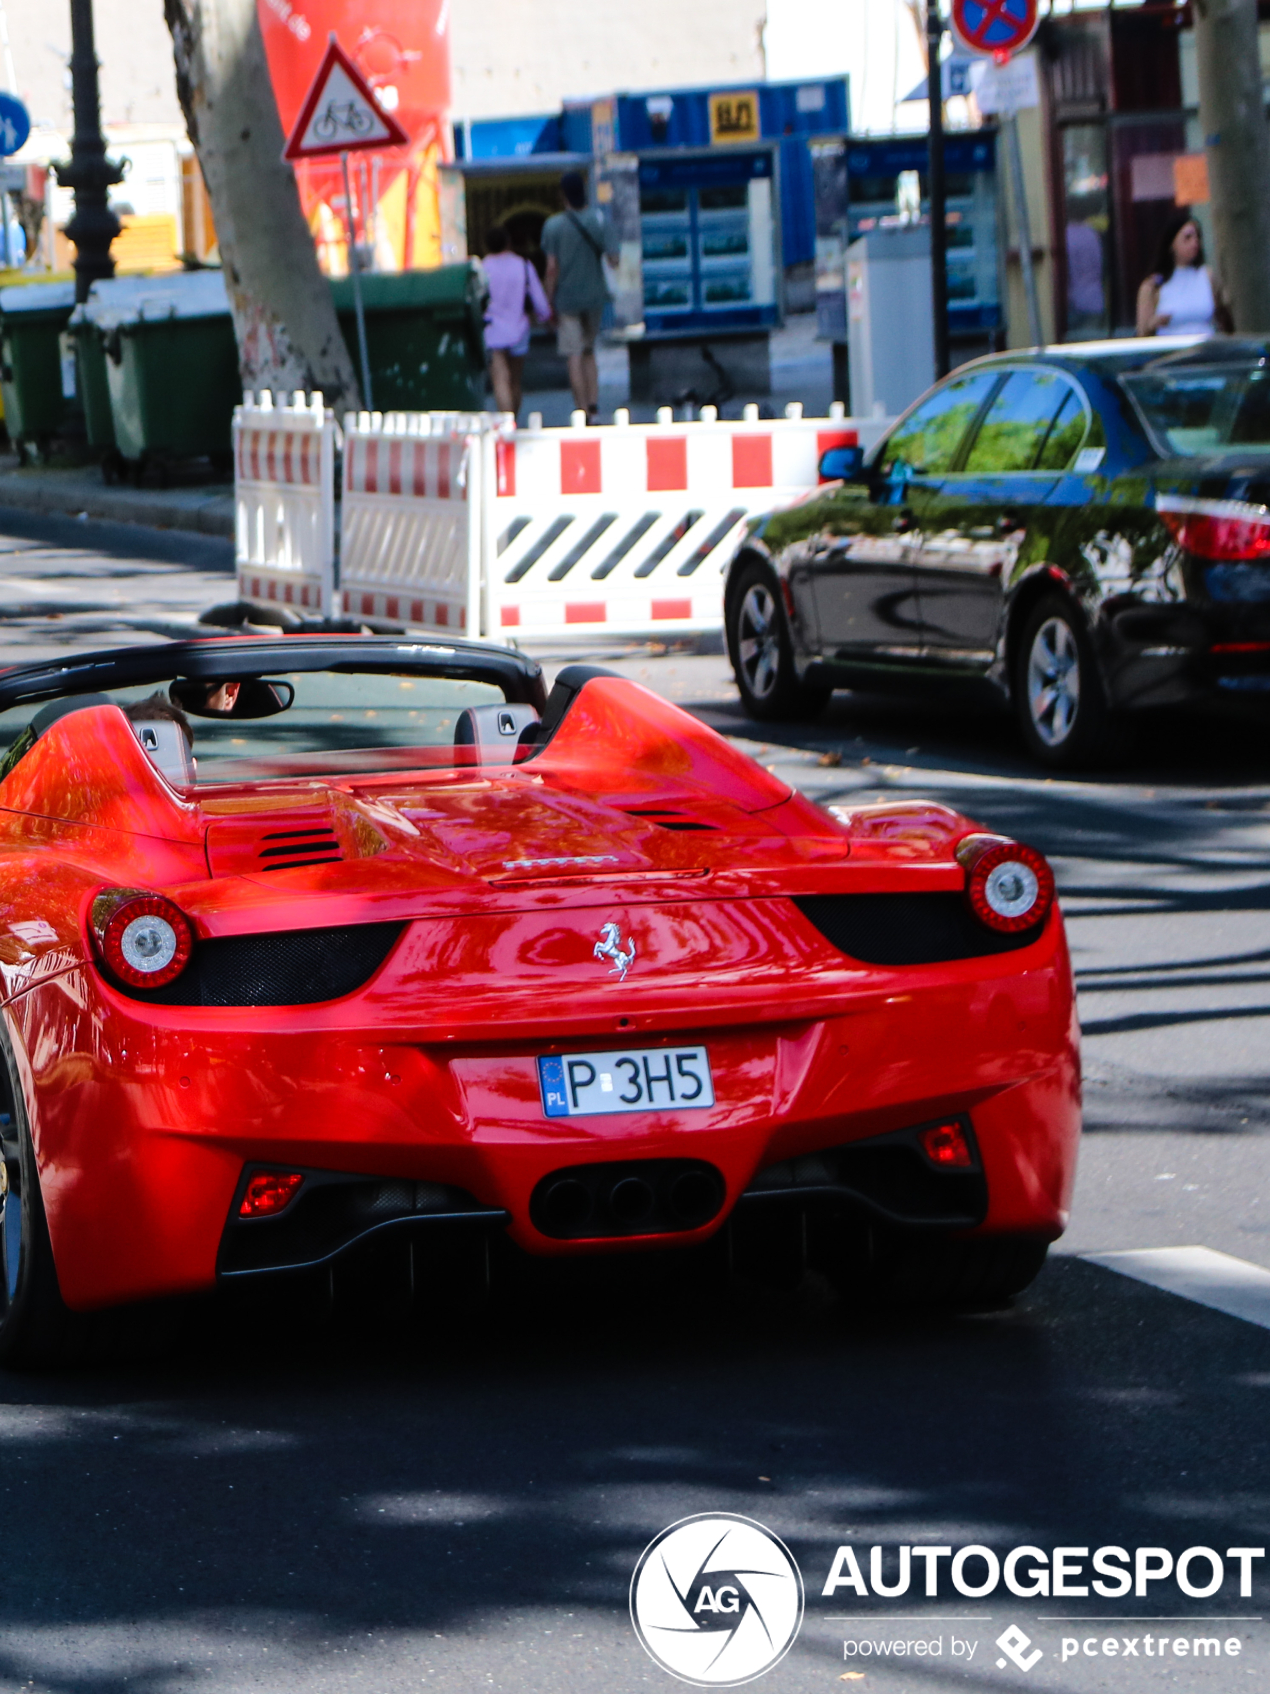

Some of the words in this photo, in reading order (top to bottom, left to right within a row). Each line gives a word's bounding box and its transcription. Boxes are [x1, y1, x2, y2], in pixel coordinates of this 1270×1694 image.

[567, 1059, 597, 1108] P
[615, 1053, 703, 1104] 3H5
[547, 1092, 566, 1106] PL
